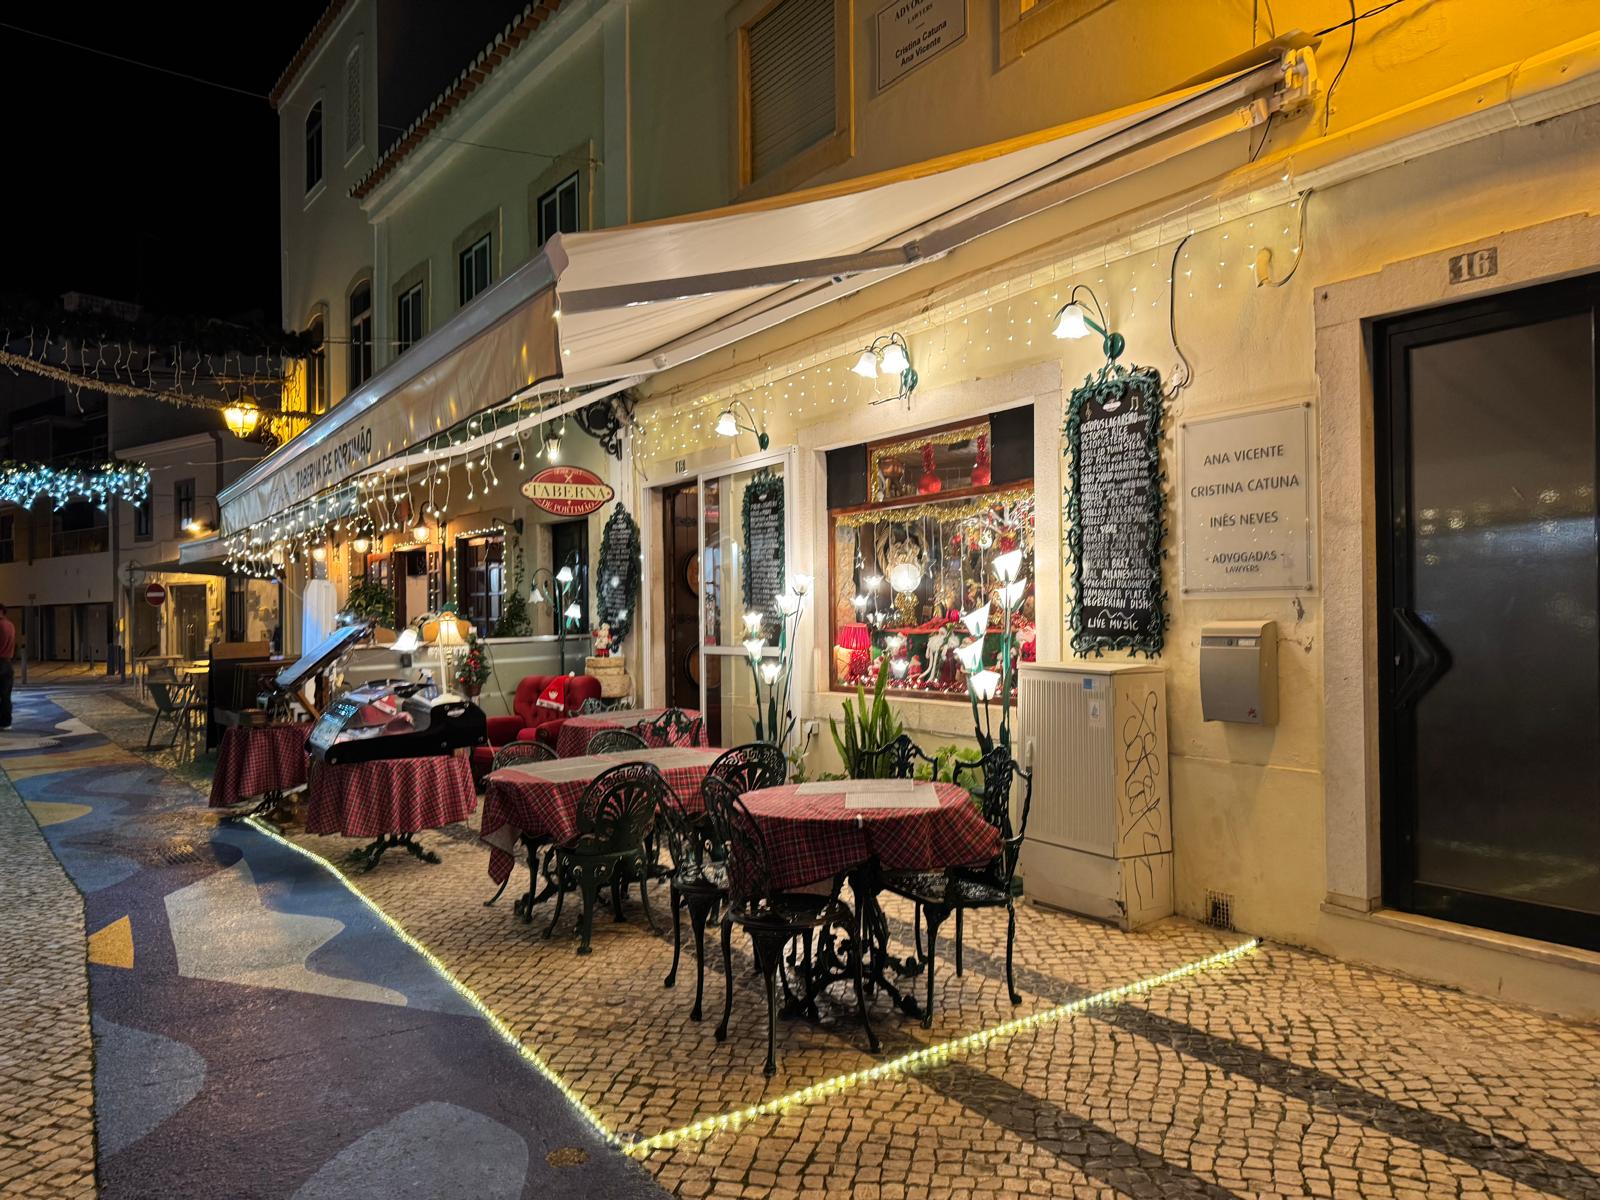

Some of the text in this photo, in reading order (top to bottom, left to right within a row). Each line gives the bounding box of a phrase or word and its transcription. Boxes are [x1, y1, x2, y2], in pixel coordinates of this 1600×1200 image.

[895, 20, 947, 59] Cristina Catuna
[900, 36, 942, 67] Ana Vicente
[1457, 250, 1490, 280] 16
[1203, 444, 1285, 467] ANA VICENTE
[528, 483, 606, 499] TABERNA
[1190, 474, 1300, 498] CRISTINA CATUNA
[553, 501, 596, 514] PORTIMÃO
[1210, 511, 1279, 528] INÊS NEVES
[1212, 550, 1277, 564] ADVOGADAS
[1225, 564, 1260, 574] LAWYERS
[1125, 589, 1147, 599] PLATE
[1088, 617, 1139, 631] LIVE MUSIC
